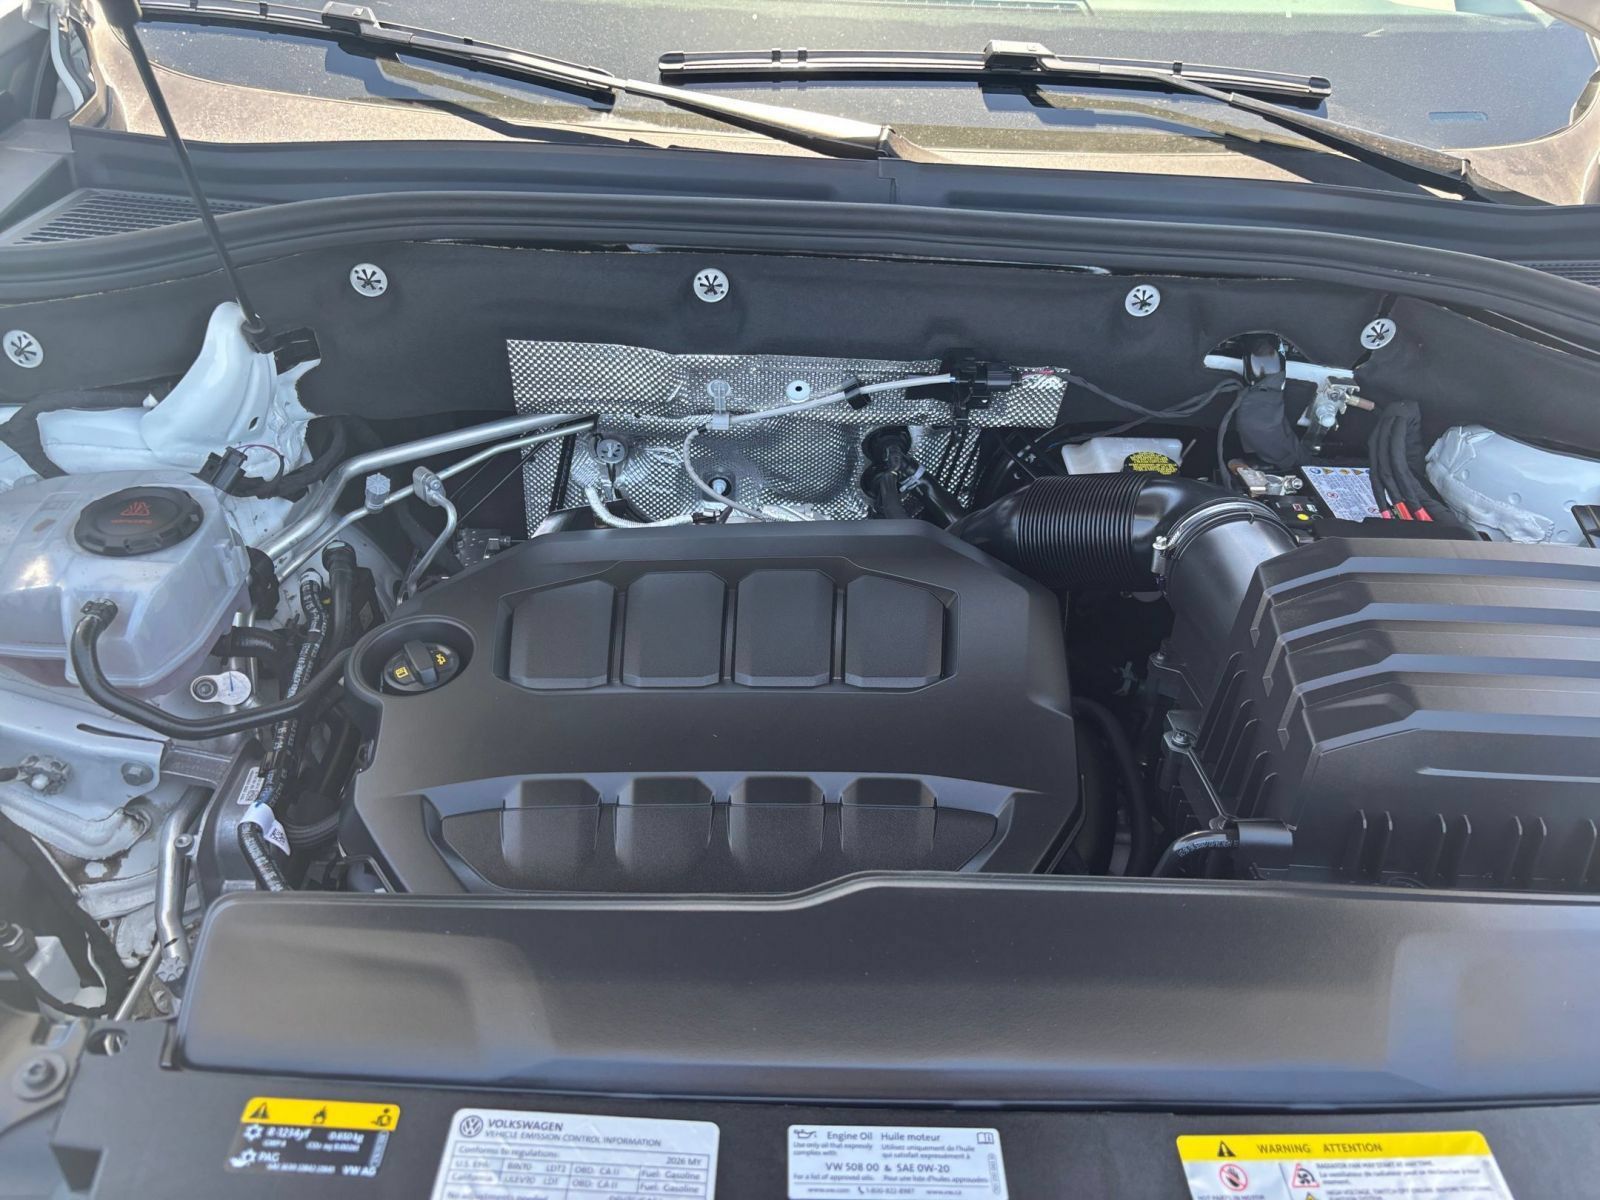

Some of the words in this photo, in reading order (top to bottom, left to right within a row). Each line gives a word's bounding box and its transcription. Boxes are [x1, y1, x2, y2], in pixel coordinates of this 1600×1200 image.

[488, 1118, 564, 1132] VOLKSWAGEN
[485, 1130, 517, 1140] VEHICLE
[519, 1131, 560, 1142] EMISSION
[562, 1134, 600, 1144] CONTROL
[603, 1136, 662, 1147] INFORMATION
[826, 1131, 857, 1142] Engine
[859, 1131, 873, 1140] Oil
[881, 1132, 905, 1141] Huile
[907, 1133, 940, 1142] moteur
[1256, 1143, 1311, 1154] WARNING
[1323, 1143, 1383, 1153] ATTENTION
[666, 1156, 686, 1166] 2026
[825, 1162, 843, 1171] VW
[845, 1162, 864, 1172] 508
[866, 1163, 880, 1172] 00
[884, 1164, 892, 1172] &
[896, 1162, 915, 1172] SAE
[917, 1163, 950, 1173] 0W-20
[664, 1170, 701, 1180] Gasoline
[663, 1183, 700, 1193] Gasoline
